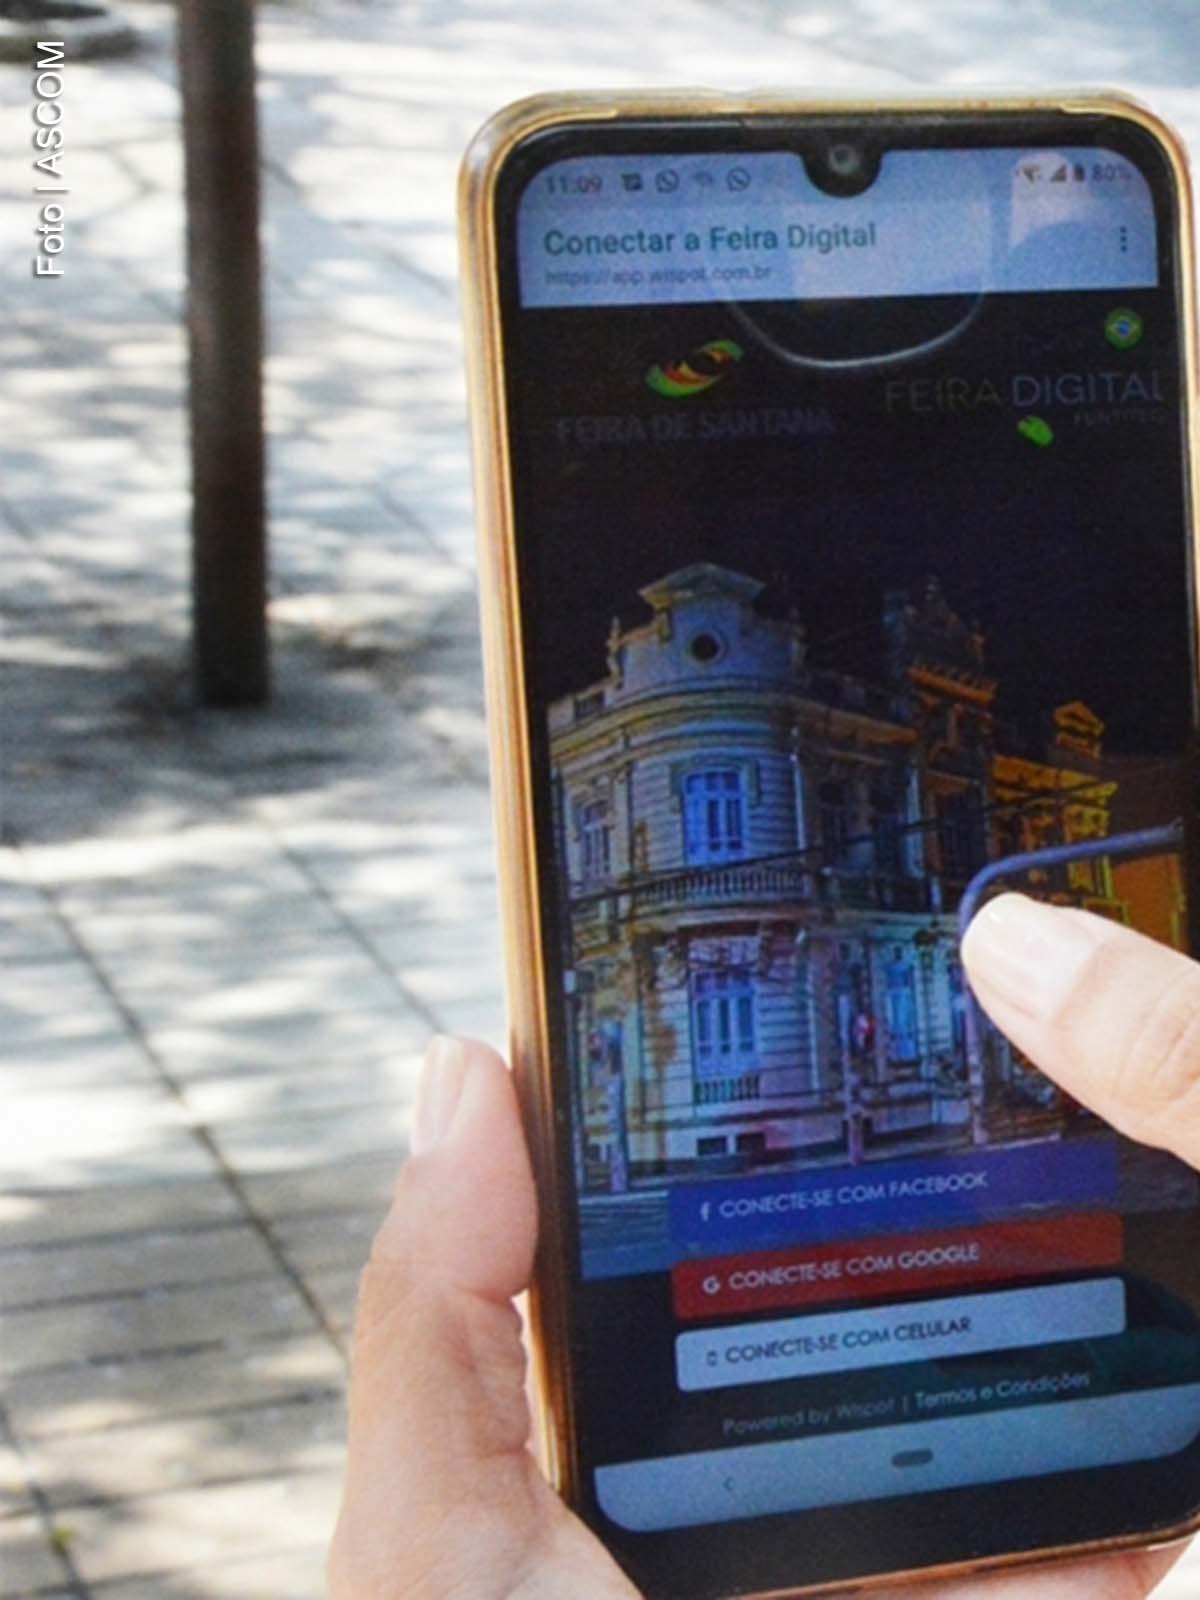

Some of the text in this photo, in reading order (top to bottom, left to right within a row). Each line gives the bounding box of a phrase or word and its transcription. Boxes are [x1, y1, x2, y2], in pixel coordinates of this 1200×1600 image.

[543, 221, 877, 256] Conectar a Feira Digital
[884, 369, 1165, 414] FEIRA DIGITAL
[719, 1188, 834, 1218] CONECTE-SE
[837, 1183, 886, 1204] COM
[888, 1171, 988, 1197] FACEBOOK
[728, 1258, 842, 1290] CONECTE-SE
[846, 1254, 894, 1275] COM
[898, 1243, 980, 1269] GOOGLE
[724, 1317, 973, 1364] CONECTE-SE COM CELULAR
[723, 1410, 804, 1435] Powered
[807, 1405, 832, 1426] by
[916, 1388, 977, 1410] Termos
[980, 1387, 991, 1399] e
[994, 1370, 1091, 1398] Condições
